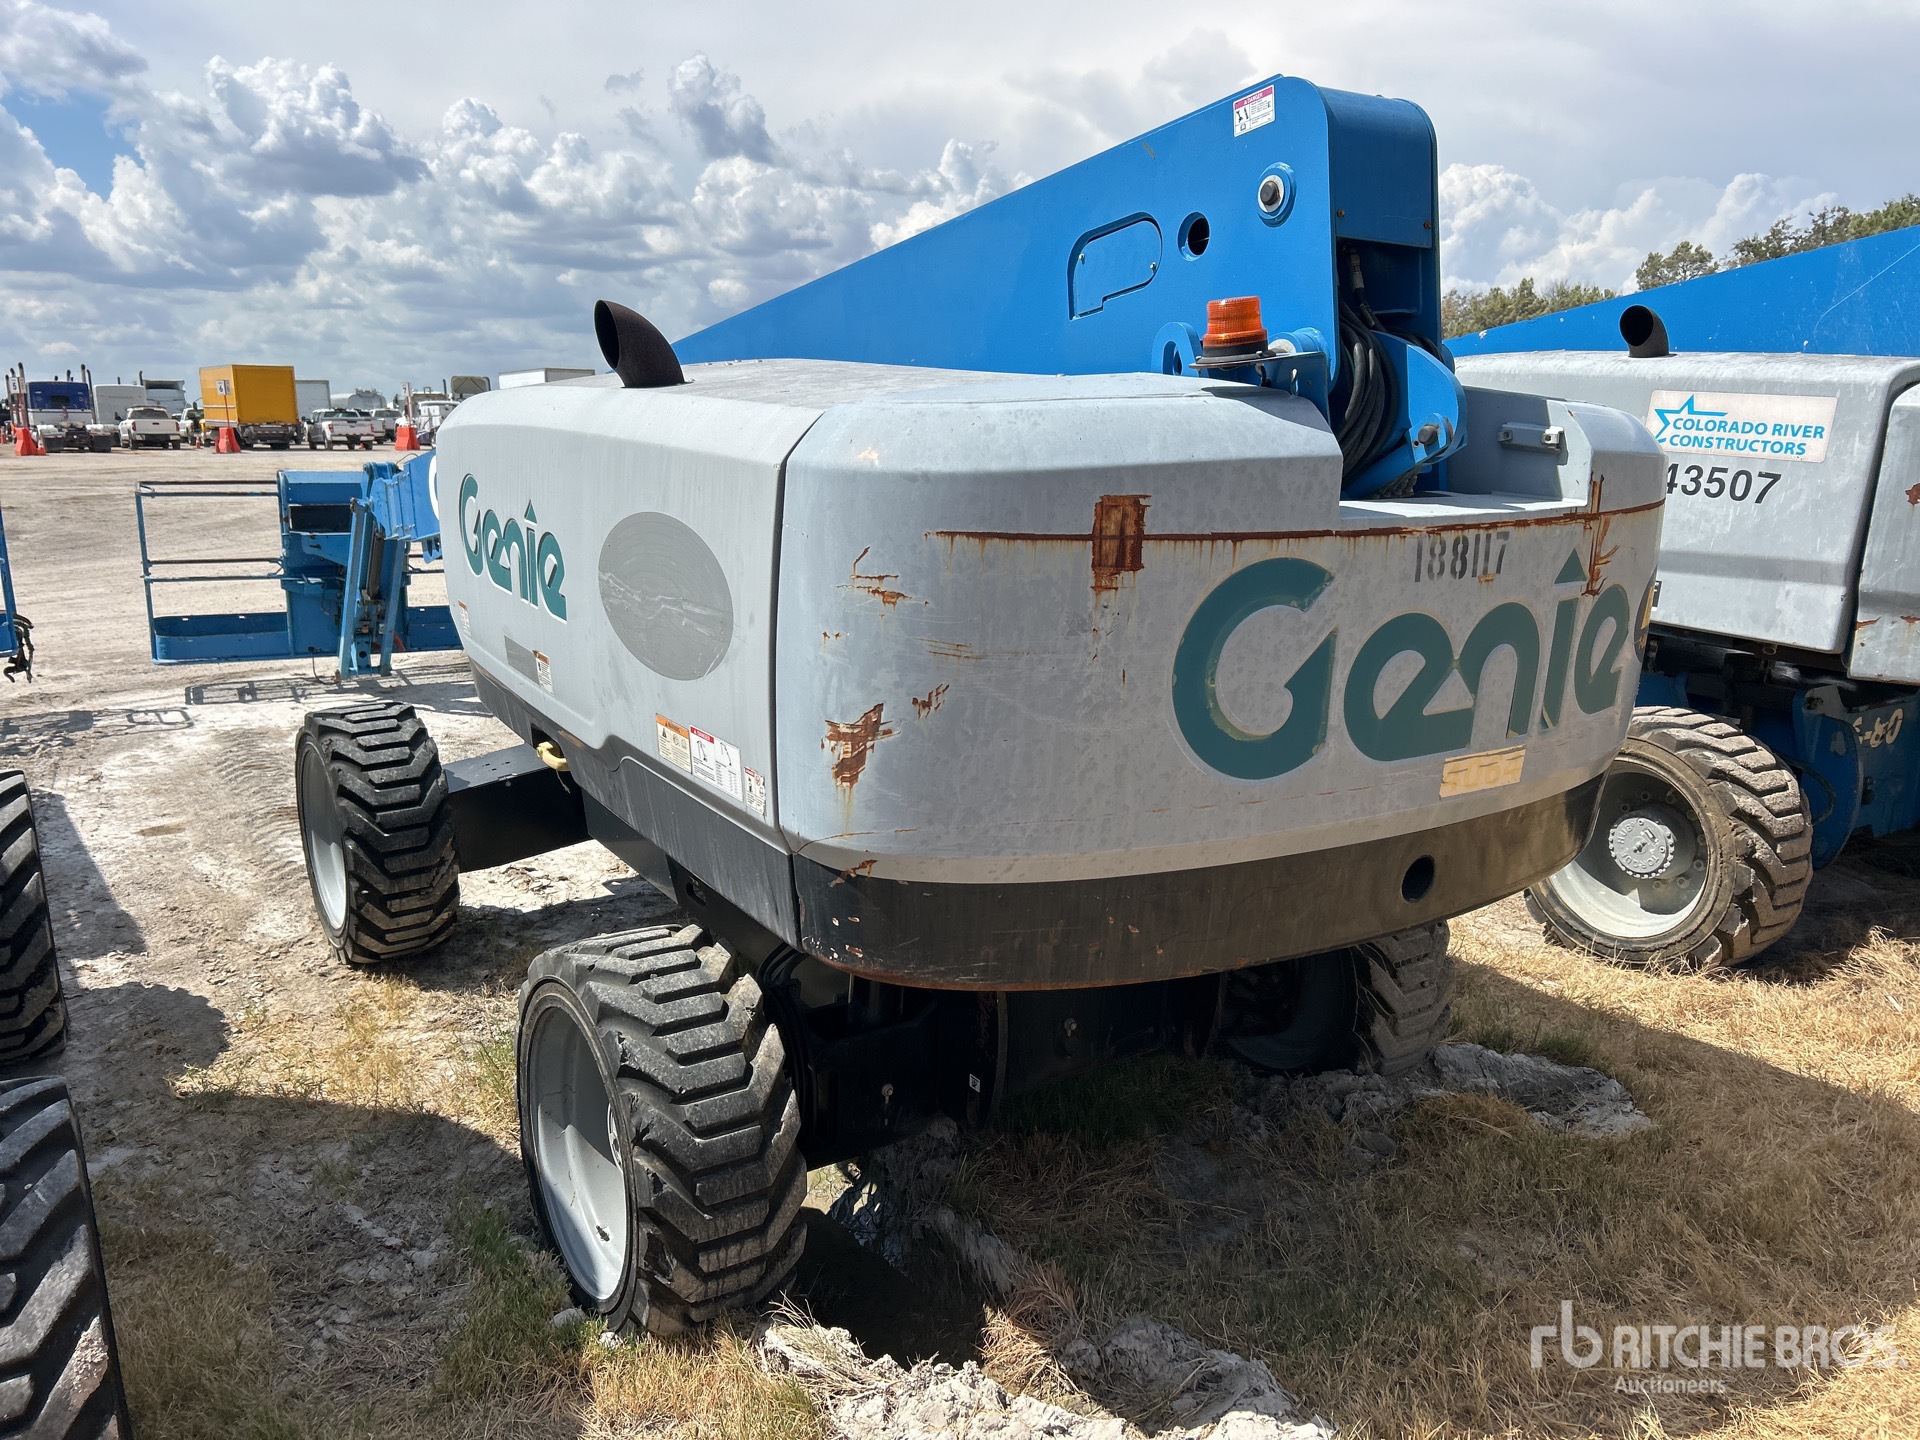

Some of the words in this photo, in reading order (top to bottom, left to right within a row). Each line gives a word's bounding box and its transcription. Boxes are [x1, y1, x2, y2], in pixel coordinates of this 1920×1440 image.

[1669, 434, 1807, 456] CONSTRUCTORS
[1672, 418, 1768, 436] COLORADO
[1771, 423, 1826, 439] RIVER
[1666, 463, 1782, 504] 43507
[458, 473, 567, 624] Genie
[1415, 531, 1510, 582] 188117
[1172, 548, 1630, 780] Genie
